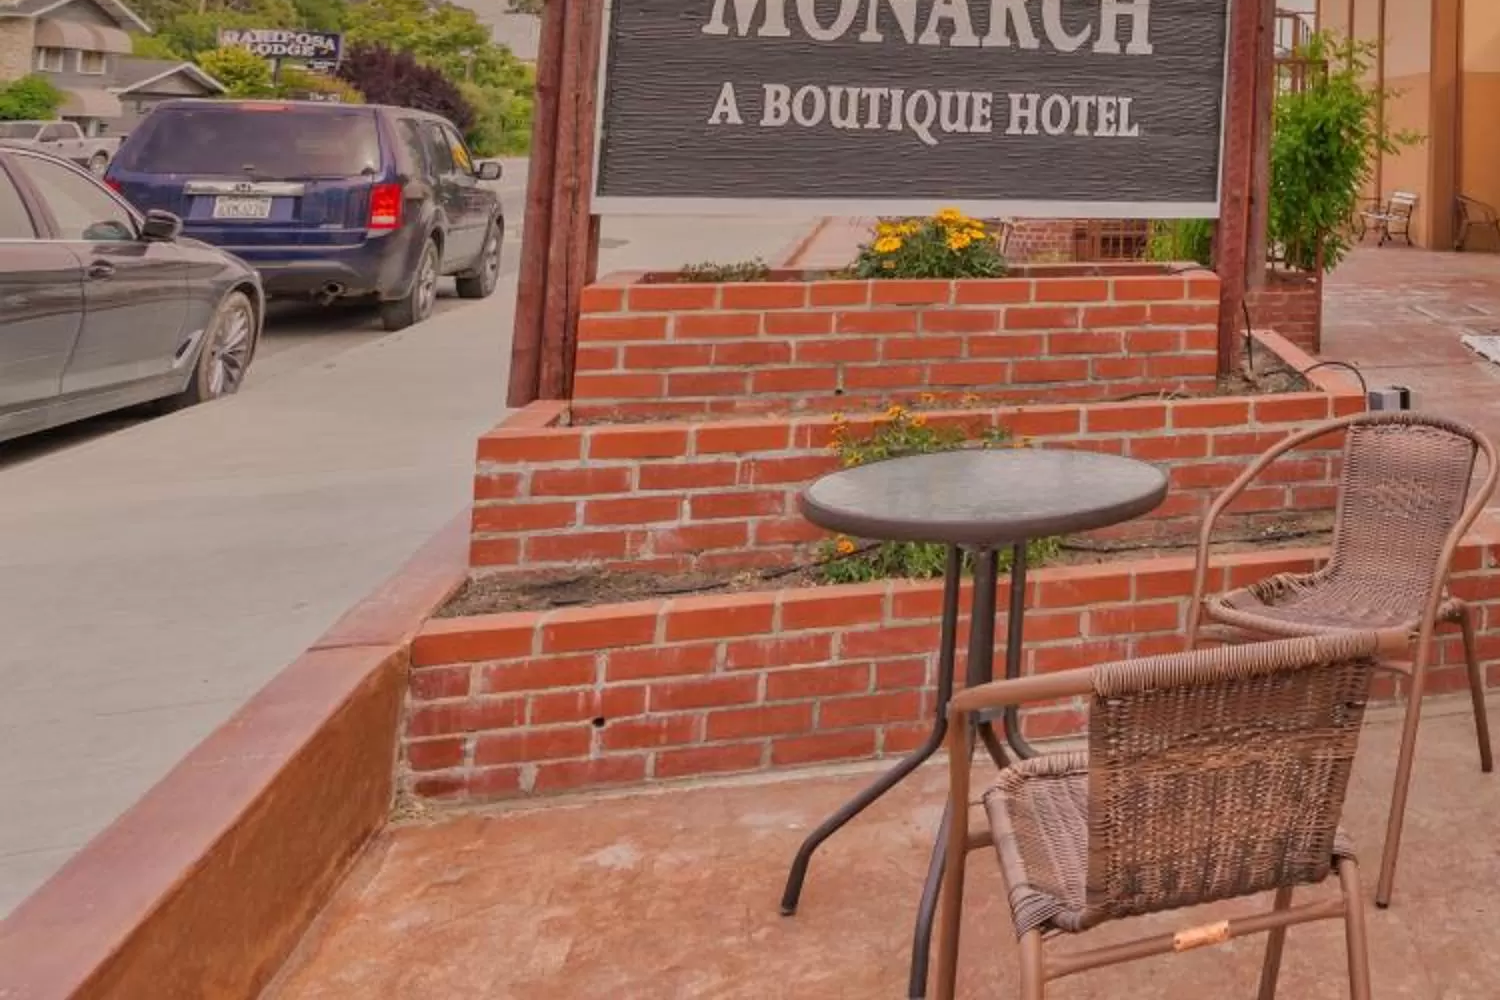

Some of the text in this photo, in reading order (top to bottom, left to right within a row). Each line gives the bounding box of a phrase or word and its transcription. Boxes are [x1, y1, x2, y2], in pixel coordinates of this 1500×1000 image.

[707, 81, 1140, 146] A BOUTIQUE HOTEL
